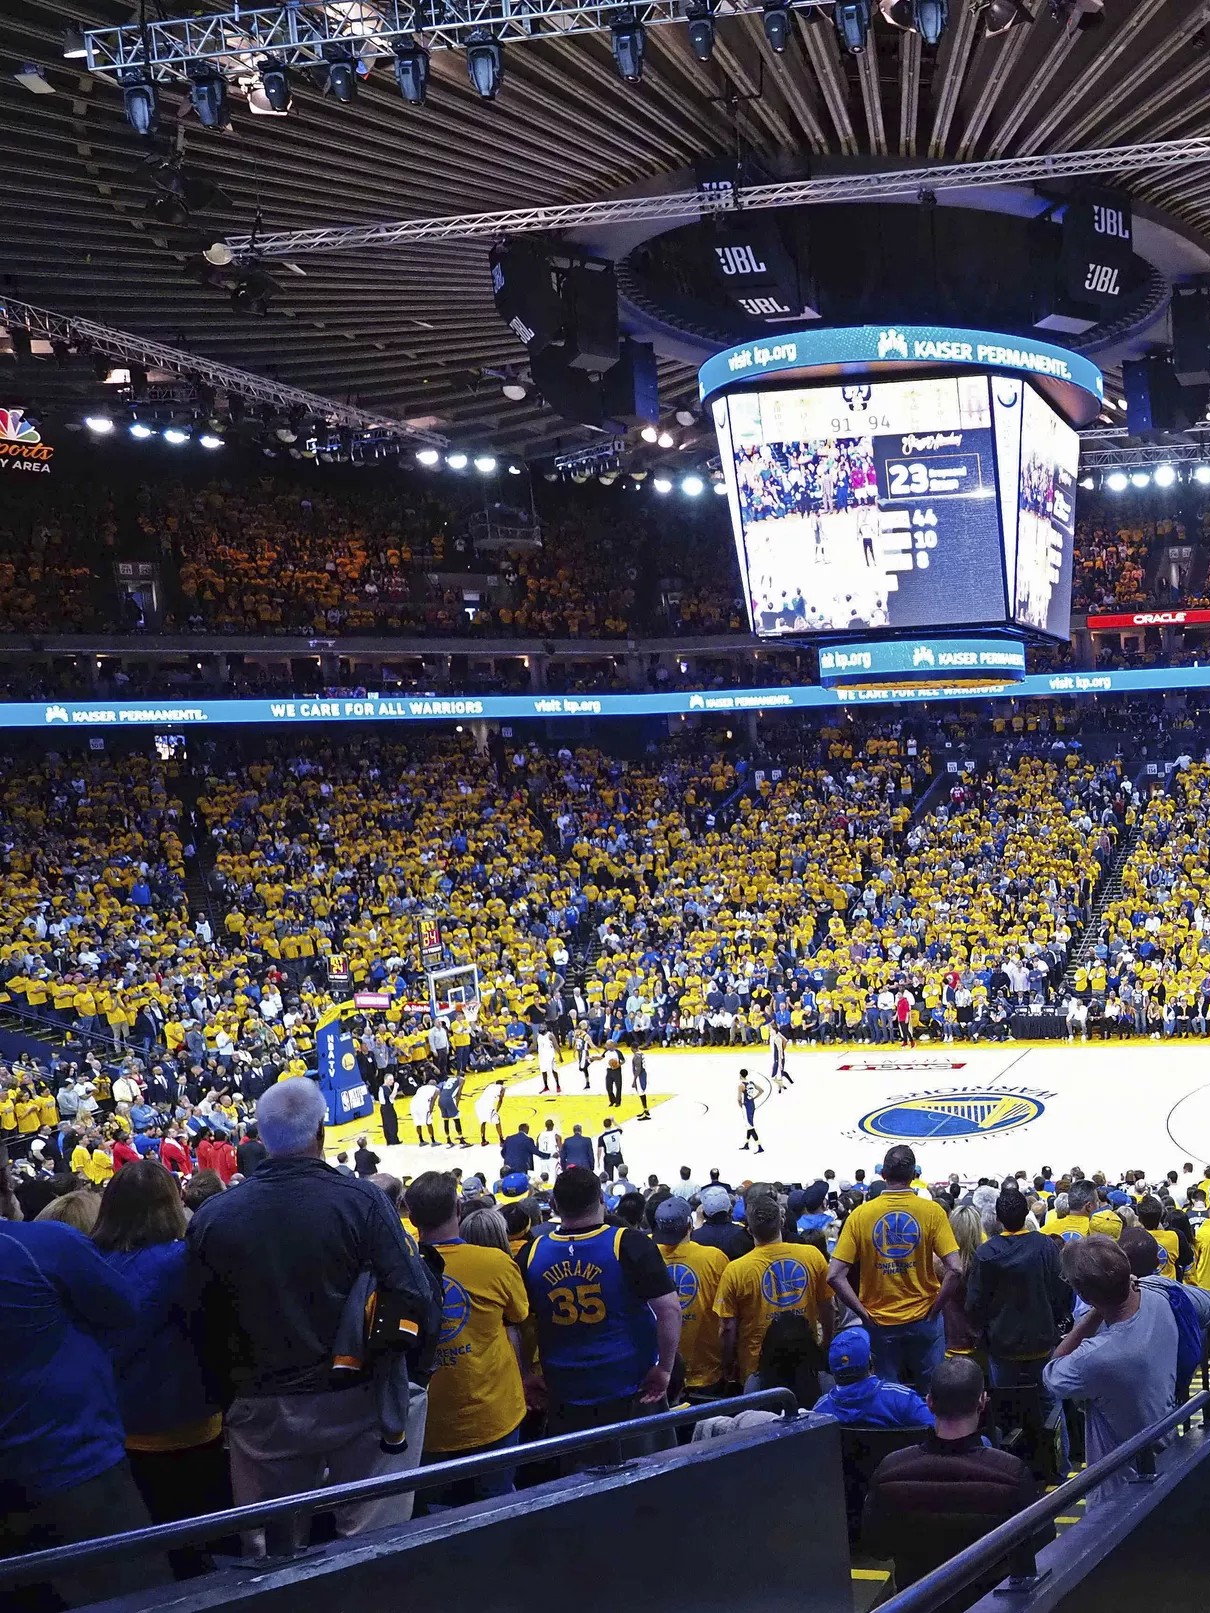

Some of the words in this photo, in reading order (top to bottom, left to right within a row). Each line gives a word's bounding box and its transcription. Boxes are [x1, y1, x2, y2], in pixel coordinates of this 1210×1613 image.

[1092, 205, 1130, 239] JBL
[715, 247, 767, 275] JBL
[1084, 263, 1121, 295] JBL
[738, 298, 791, 316] JBL
[727, 350, 753, 371] visit
[754, 343, 797, 367] kp.org
[913, 340, 974, 361] KAISER
[0, 443, 54, 460] ports
[12, 461, 51, 473] AREA
[888, 463, 929, 495] 23
[914, 530, 938, 549] 10
[1132, 611, 1189, 626] ORACLE
[937, 652, 978, 666] KAISER
[1049, 676, 1074, 690] visit
[1075, 675, 1112, 691] kp.org
[270, 703, 296, 717] WE
[300, 703, 340, 717] CARE
[344, 703, 375, 716] FOR
[378, 702, 404, 716] ALL
[408, 701, 484, 715] WARRIORS
[534, 699, 562, 712] visit
[563, 698, 602, 714] kp.org
[72, 710, 117, 723] KAISER
[542, 1260, 603, 1286] DURANT
[547, 1284, 607, 1326] 35
